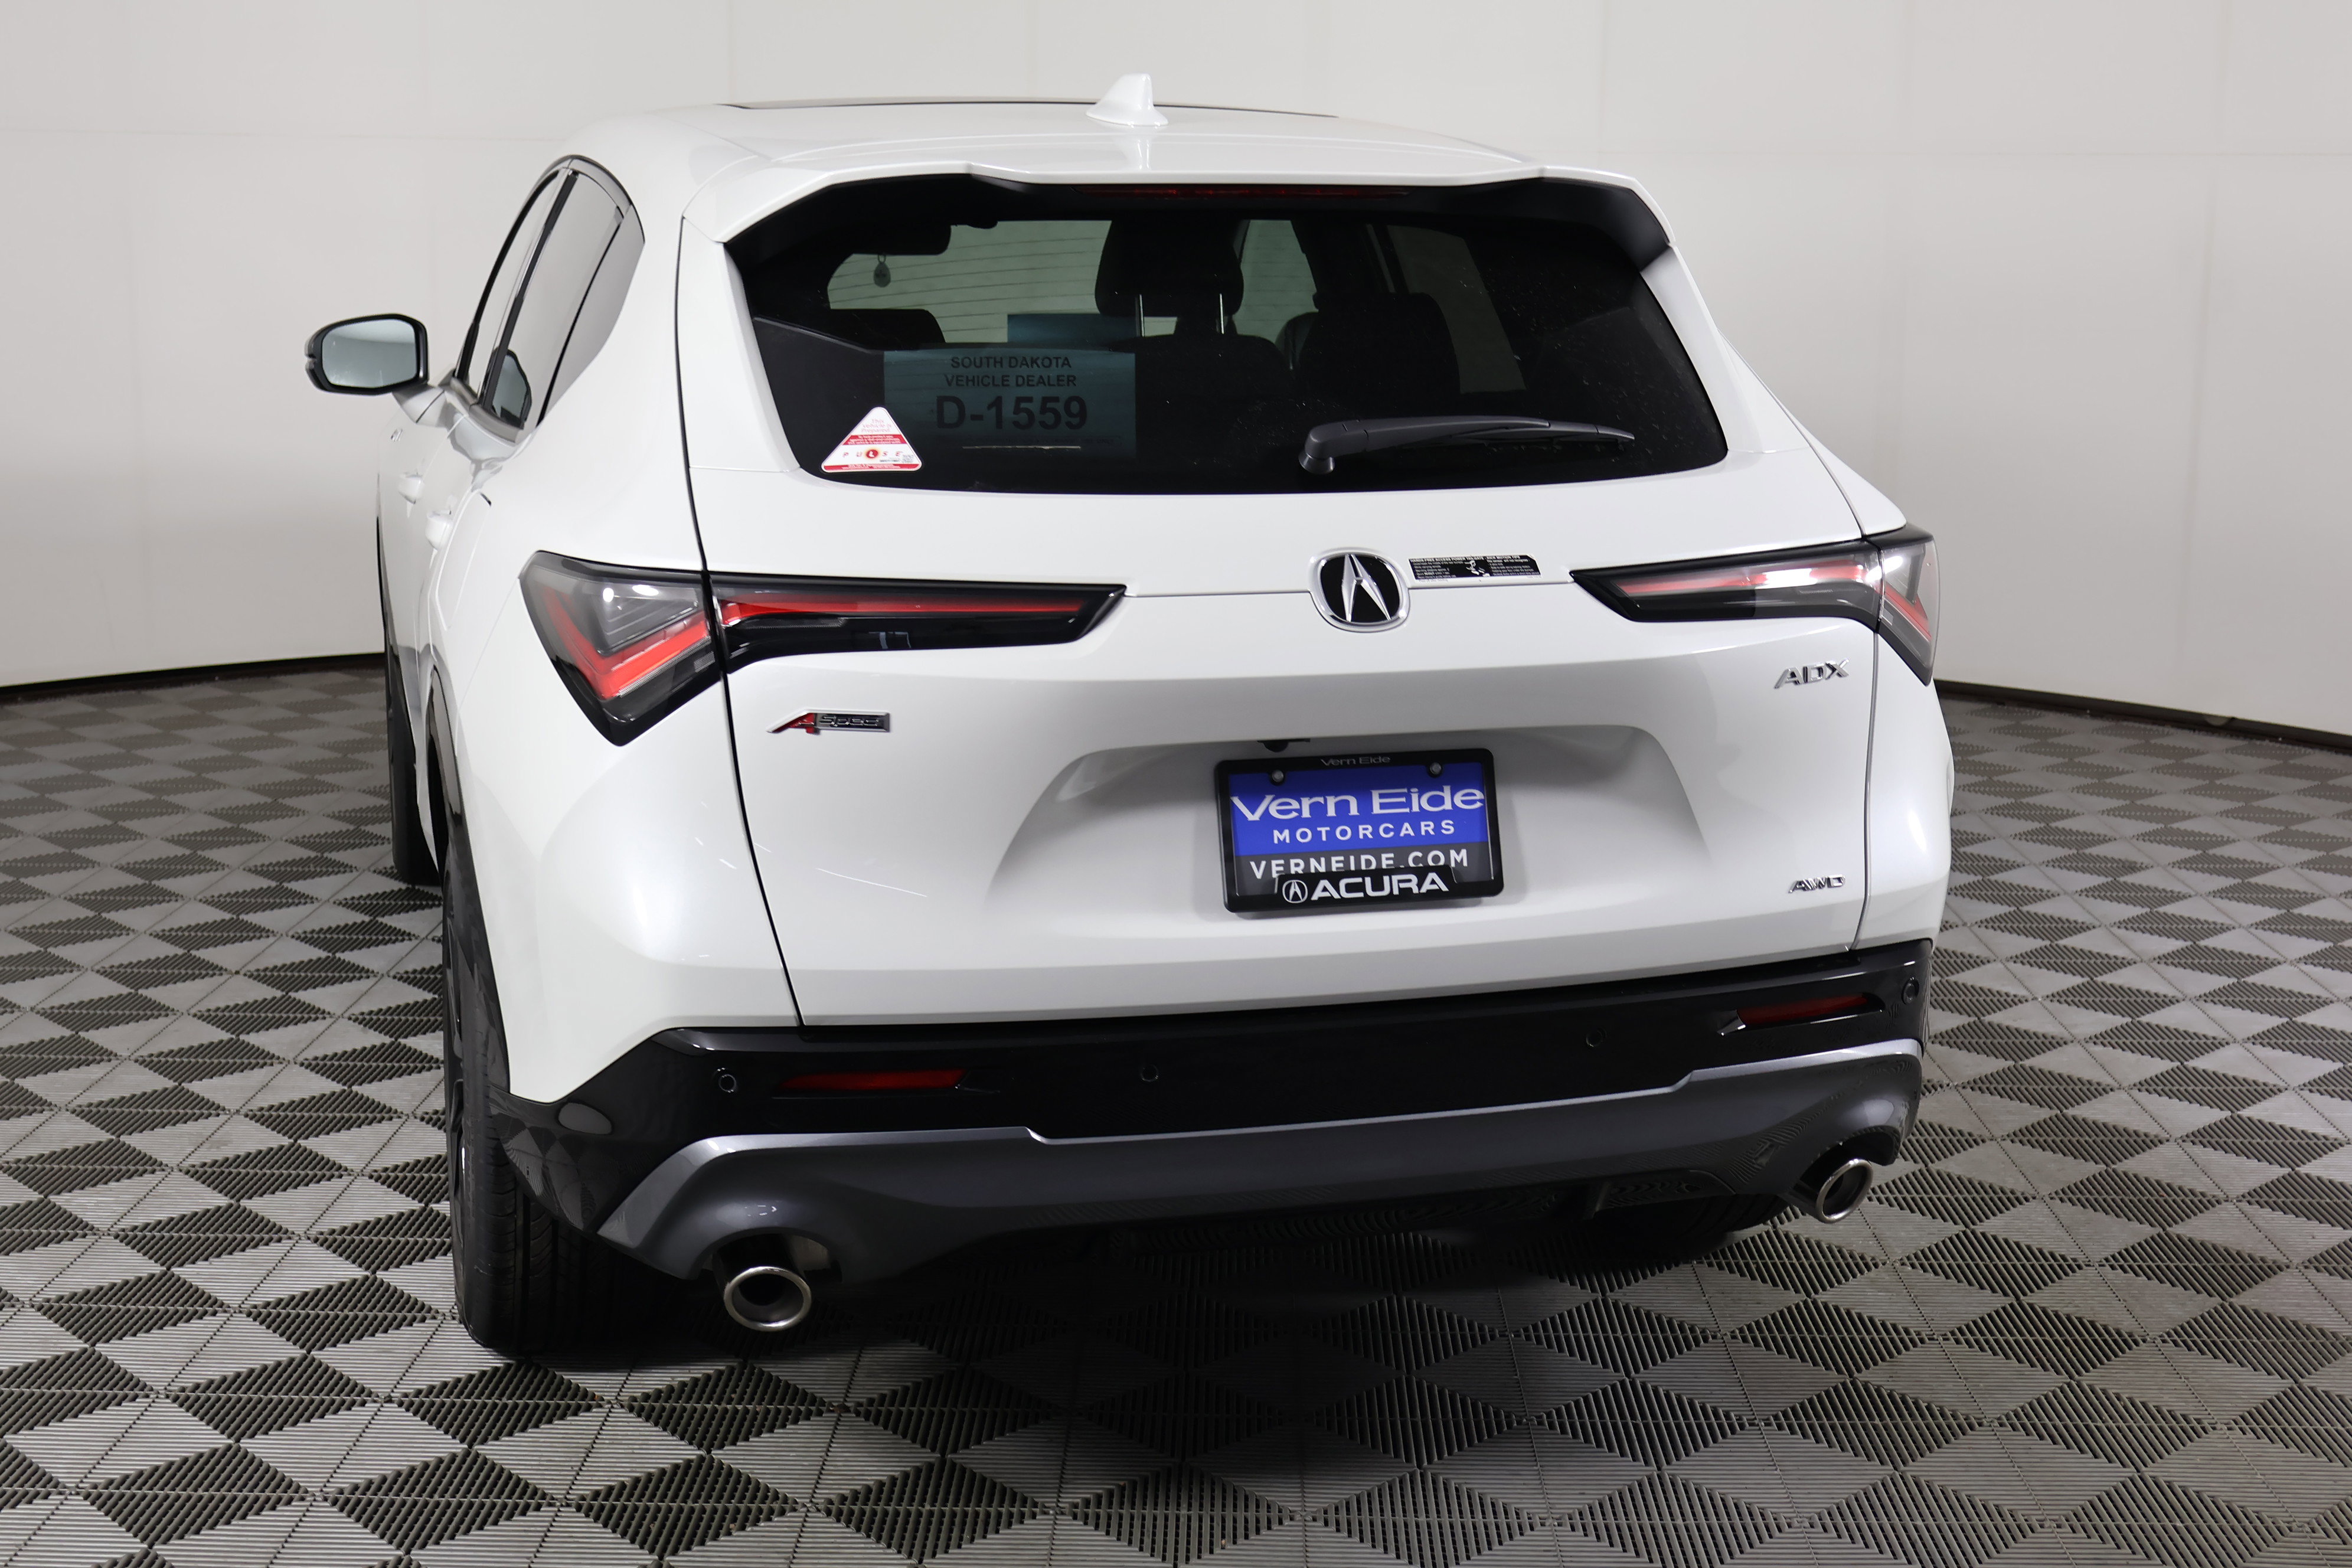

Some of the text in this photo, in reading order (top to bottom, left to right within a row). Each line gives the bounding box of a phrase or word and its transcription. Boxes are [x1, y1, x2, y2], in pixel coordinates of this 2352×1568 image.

[951, 357, 1072, 368] SOUTH DAKOTA
[945, 375, 1077, 387] VEHICLE DEALER
[936, 396, 1087, 430] D-1559
[1774, 659, 1850, 689] ADX
[1359, 756, 1391, 765] Eide
[1230, 785, 1485, 821] Vern Eide
[1273, 820, 1455, 844] MOTORCARS
[1250, 849, 1468, 879] VERNEIDE.COM
[1311, 872, 1449, 901] ACURA
[1788, 874, 1845, 893] AWD
